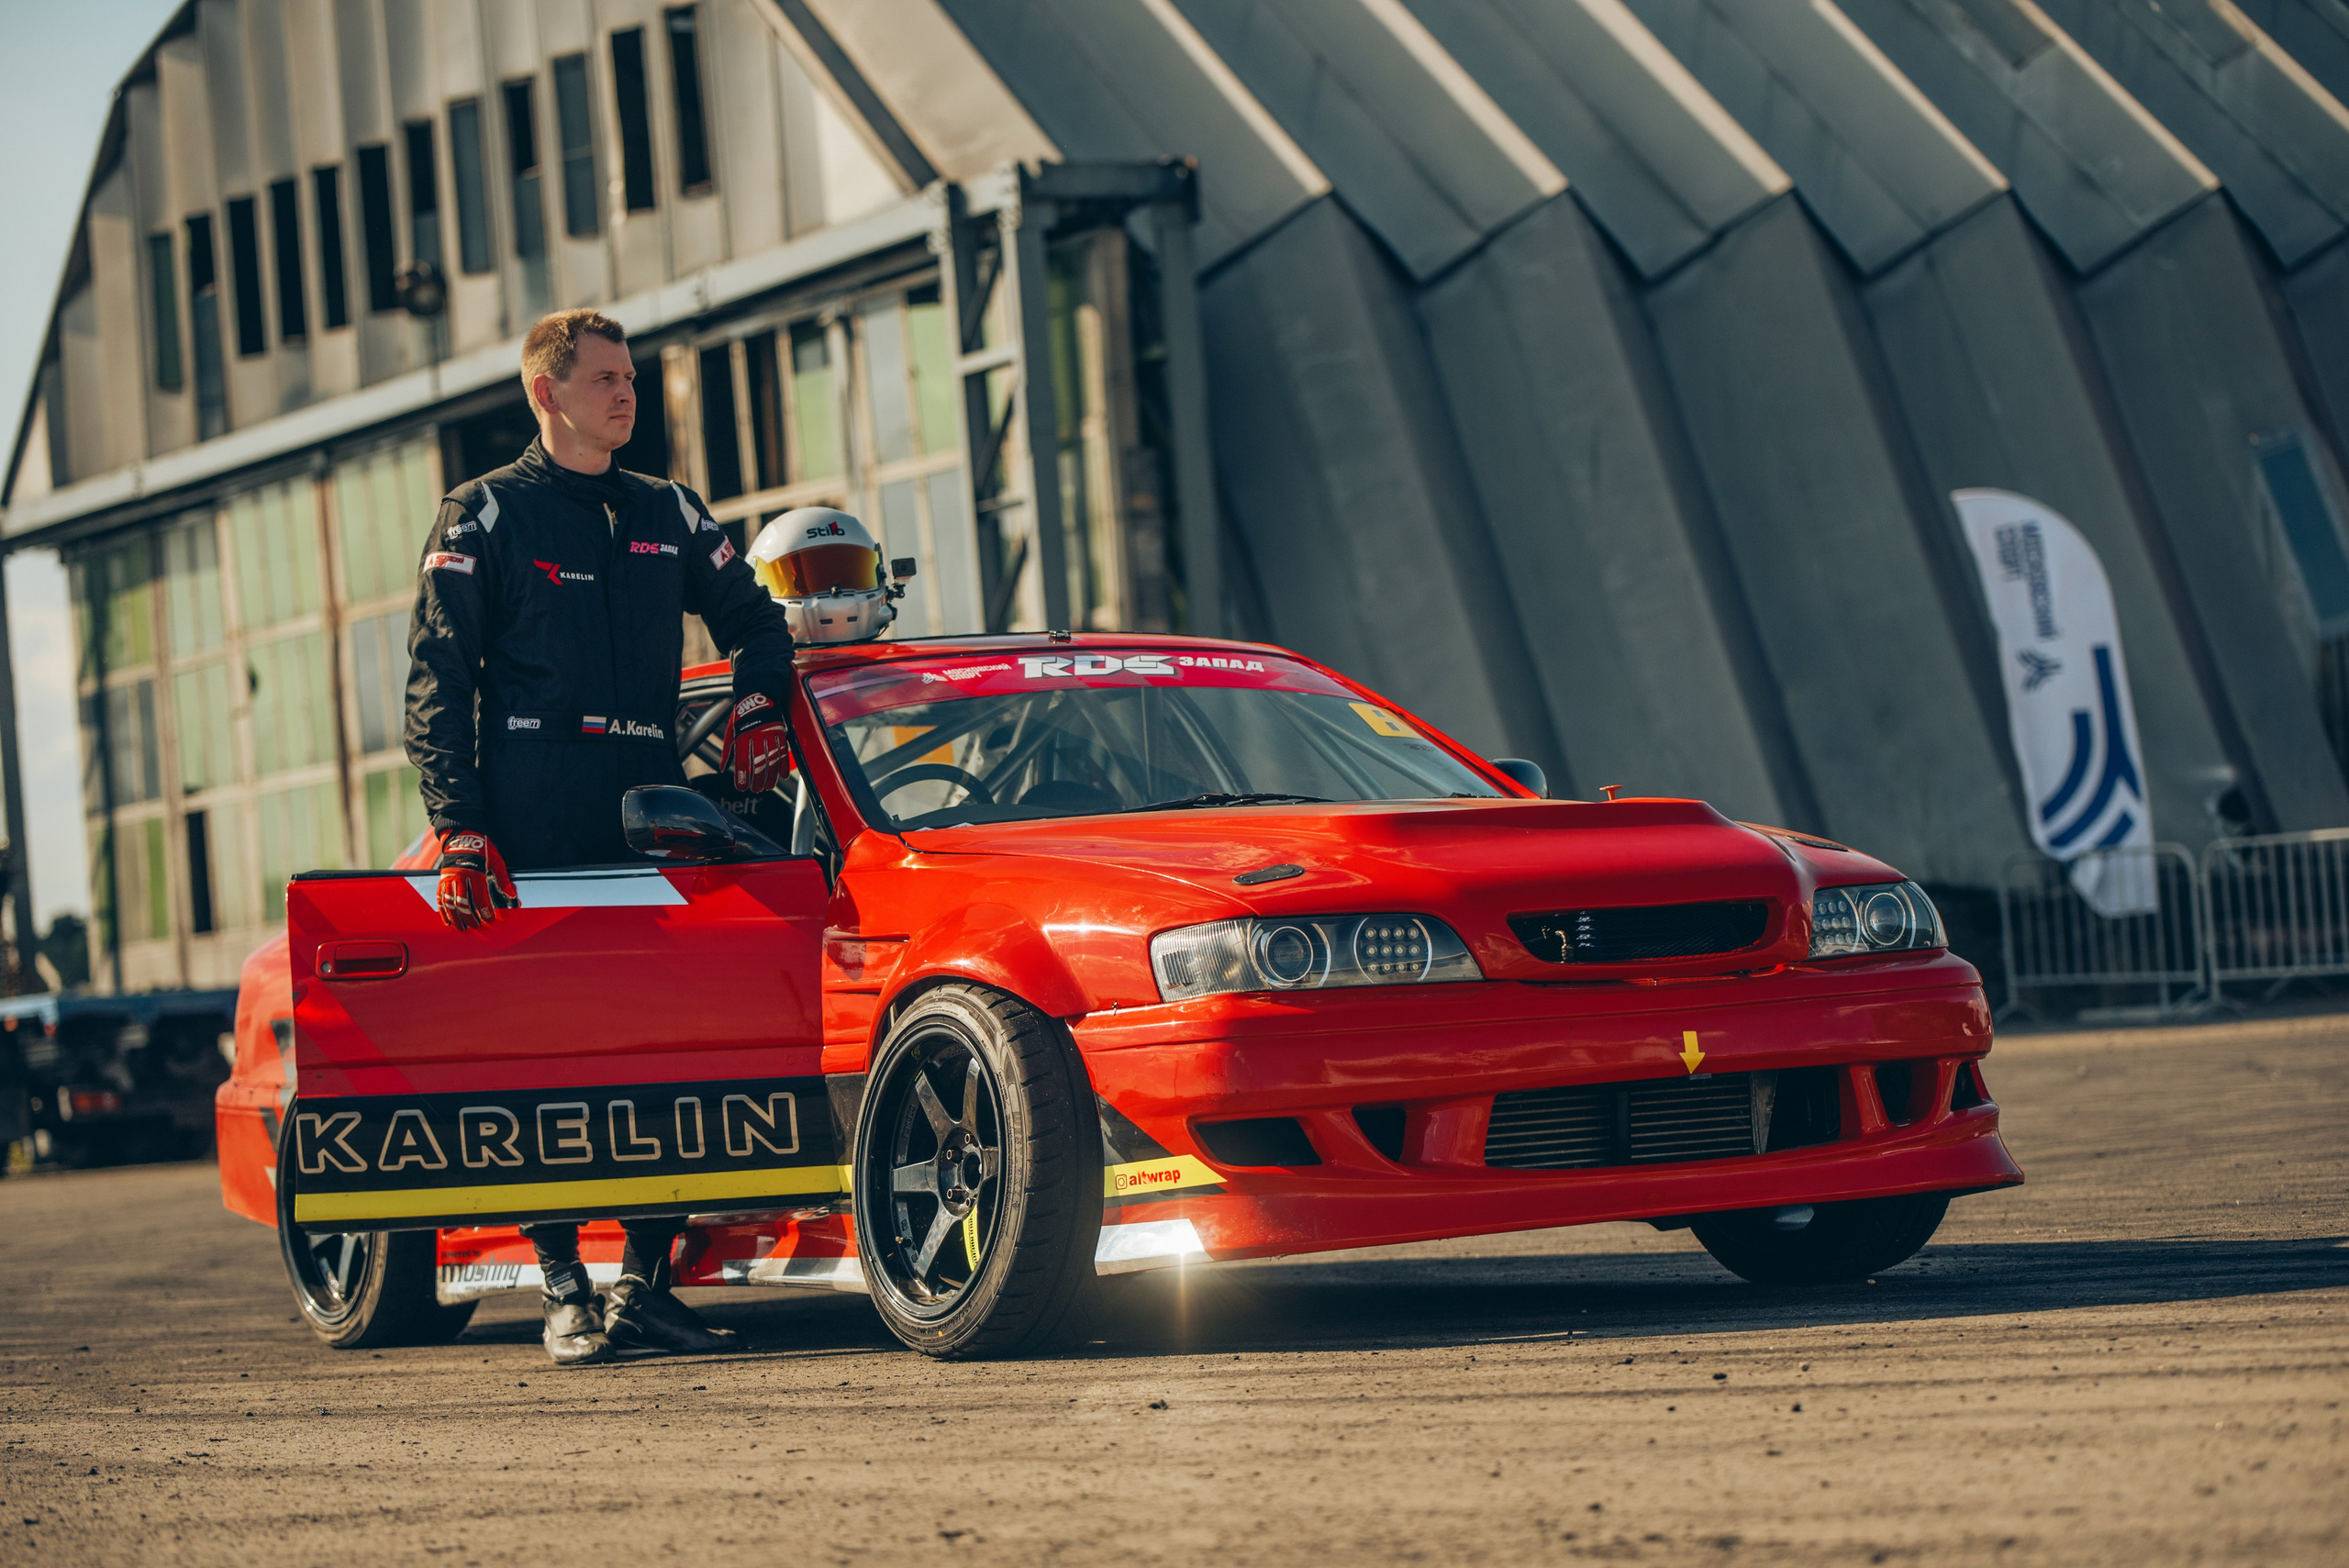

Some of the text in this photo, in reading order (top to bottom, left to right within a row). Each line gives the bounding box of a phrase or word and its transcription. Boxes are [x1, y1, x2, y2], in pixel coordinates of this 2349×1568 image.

[629, 541, 660, 554] RDS
[560, 572, 595, 581] KARELIN
[1018, 655, 1265, 678] RDS ЗАПАД
[737, 695, 767, 716] OMP
[507, 716, 540, 730] freem
[607, 718, 664, 740] A.Karelin
[295, 1092, 800, 1173] KARELIN
